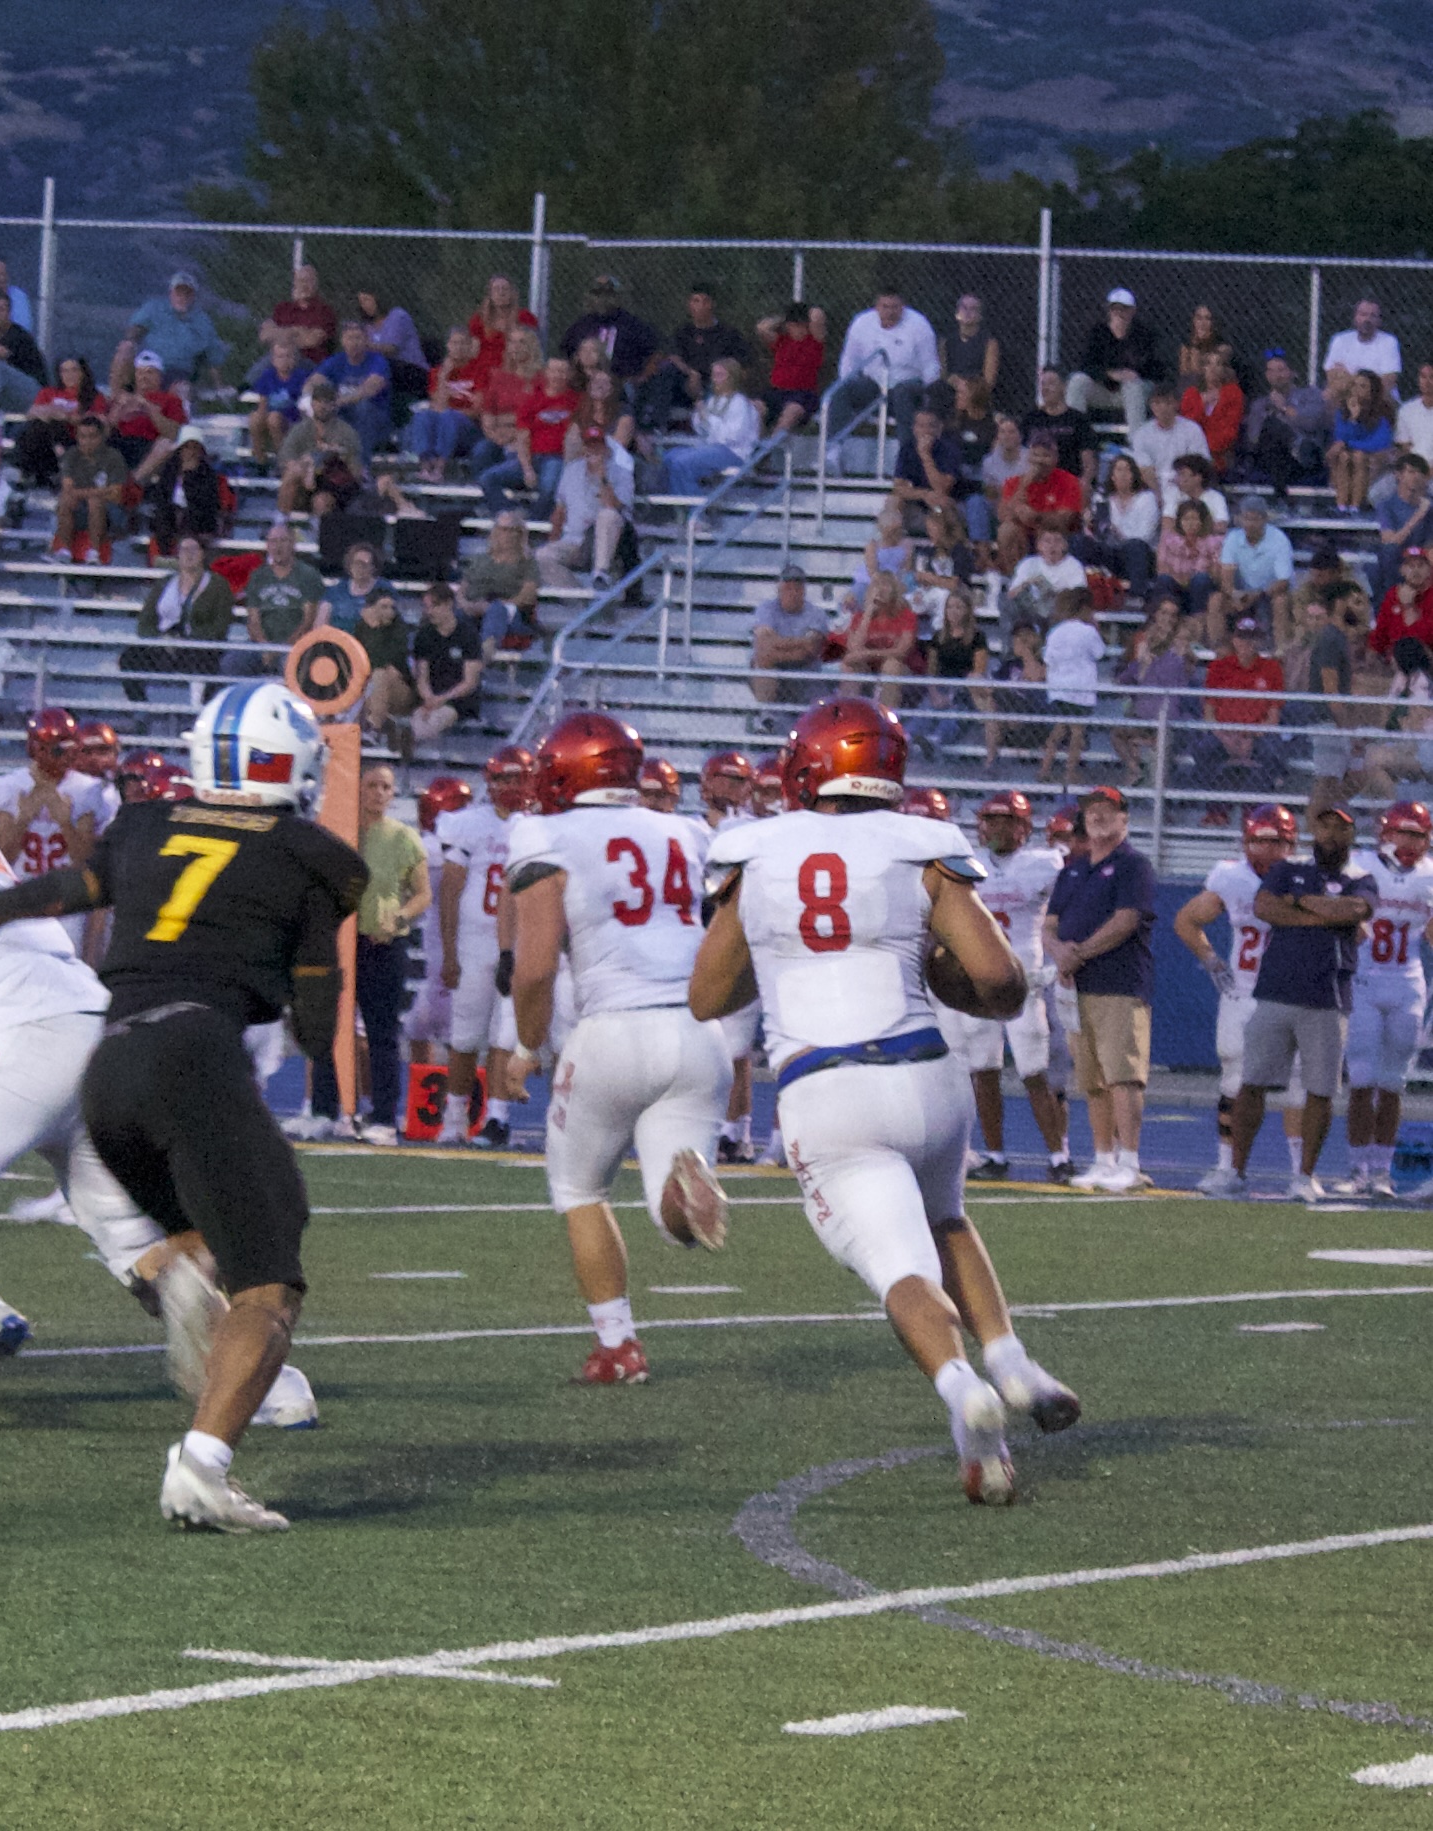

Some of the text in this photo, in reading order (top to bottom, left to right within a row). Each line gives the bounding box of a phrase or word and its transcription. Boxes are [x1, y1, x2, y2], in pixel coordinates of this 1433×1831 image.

[21, 832, 68, 873] 92
[145, 834, 240, 941] 7
[606, 837, 695, 926] 34
[798, 853, 852, 953] 8
[1372, 919, 1410, 965] 81
